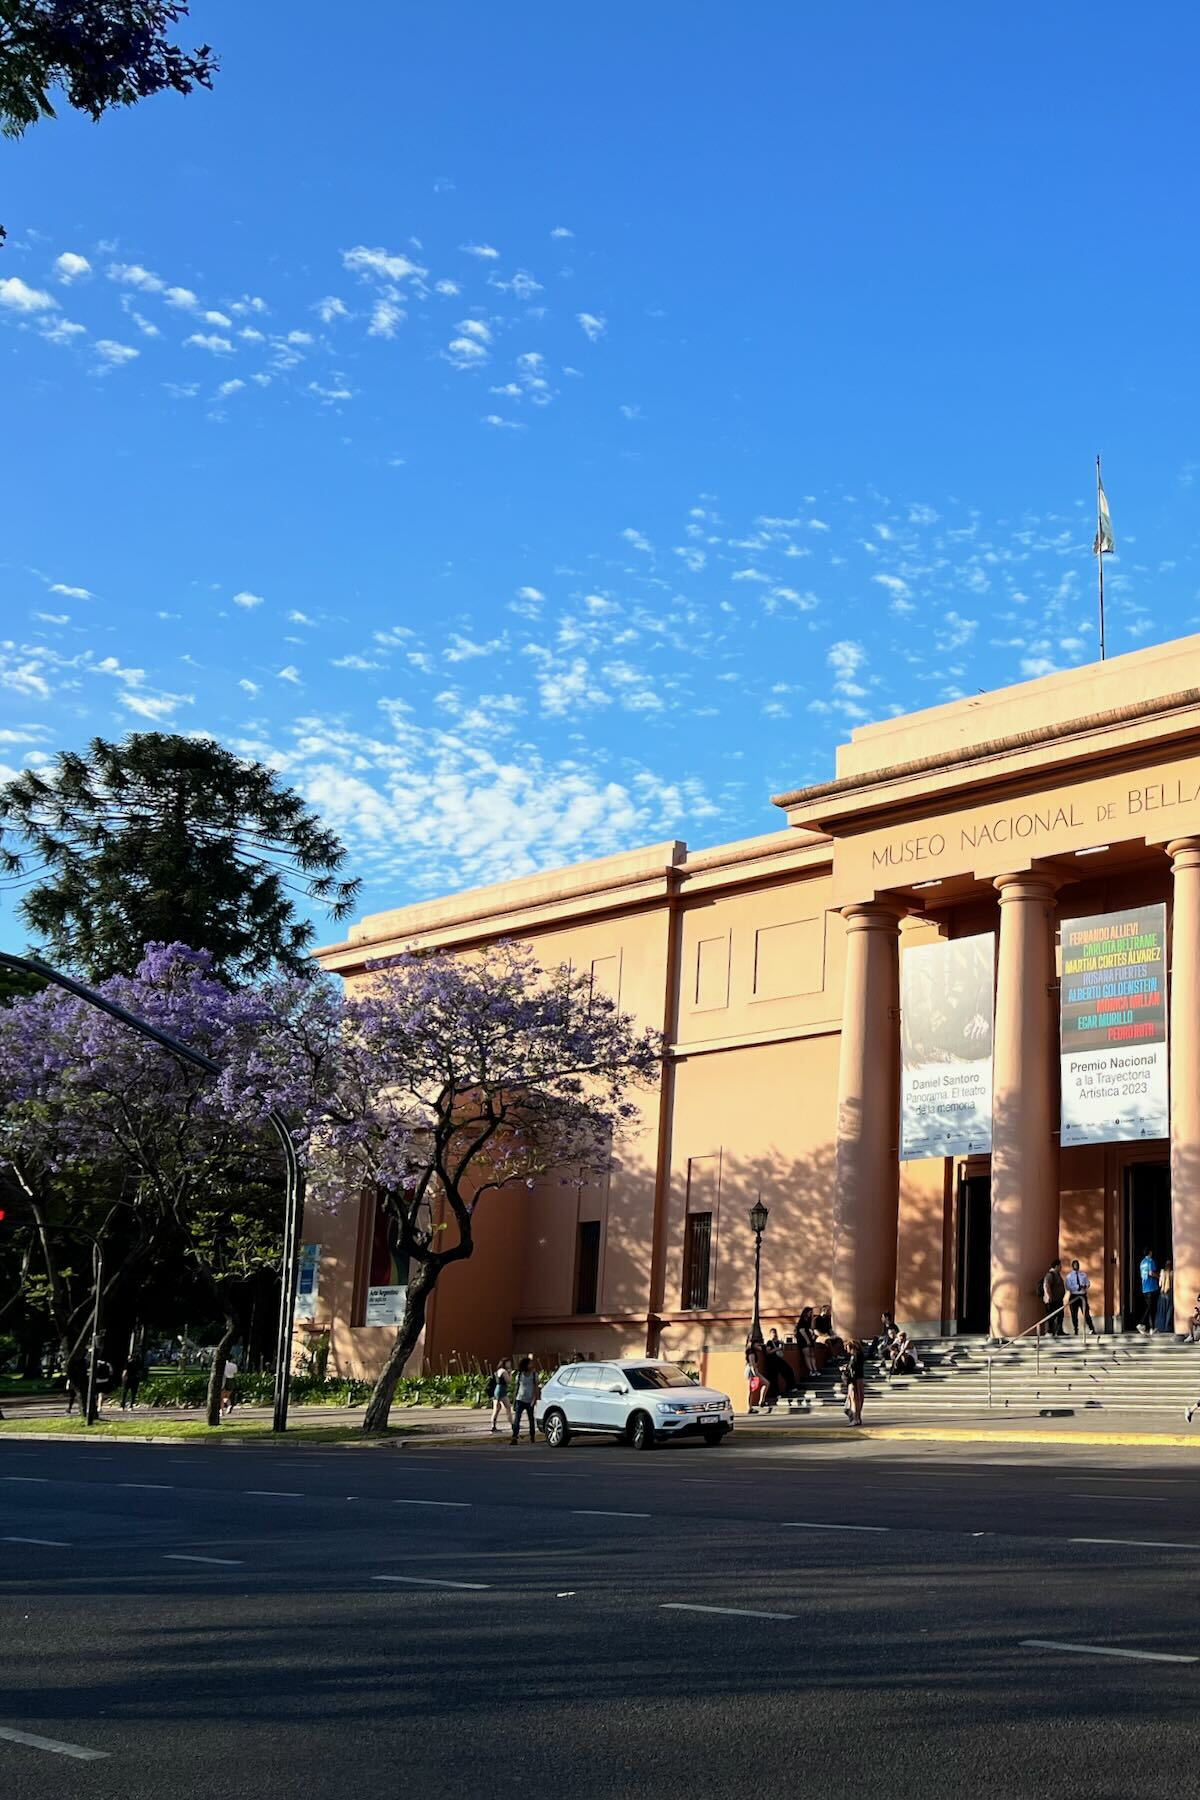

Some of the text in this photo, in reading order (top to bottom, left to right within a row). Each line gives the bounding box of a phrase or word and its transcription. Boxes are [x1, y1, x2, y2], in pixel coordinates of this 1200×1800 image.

[872, 833, 946, 870] MUSEO
[960, 803, 1084, 851] NACIONAL
[1096, 802, 1117, 822] DE
[1069, 921, 1139, 946] FERNANDO ALLIEVI
[1083, 933, 1158, 957] CARLOTA BELTRAME
[1065, 957, 1097, 974] MARTHA
[1115, 964, 1148, 981] FUERTES
[1068, 976, 1158, 1003] ALBERTO GOLDENSTEIN
[1099, 1010, 1133, 1027] MURILLO
[1108, 1025, 1133, 1041] PEDRO
[1070, 1053, 1157, 1073] Premio Nacional
[912, 1073, 980, 1090] Daniel Santoro
[1075, 1069, 1151, 1087] a la Trayectoria
[951, 1087, 960, 1099] El
[961, 1086, 986, 1097] teatro
[1122, 1082, 1148, 1096] 2023
[937, 1100, 976, 1113] memoria
